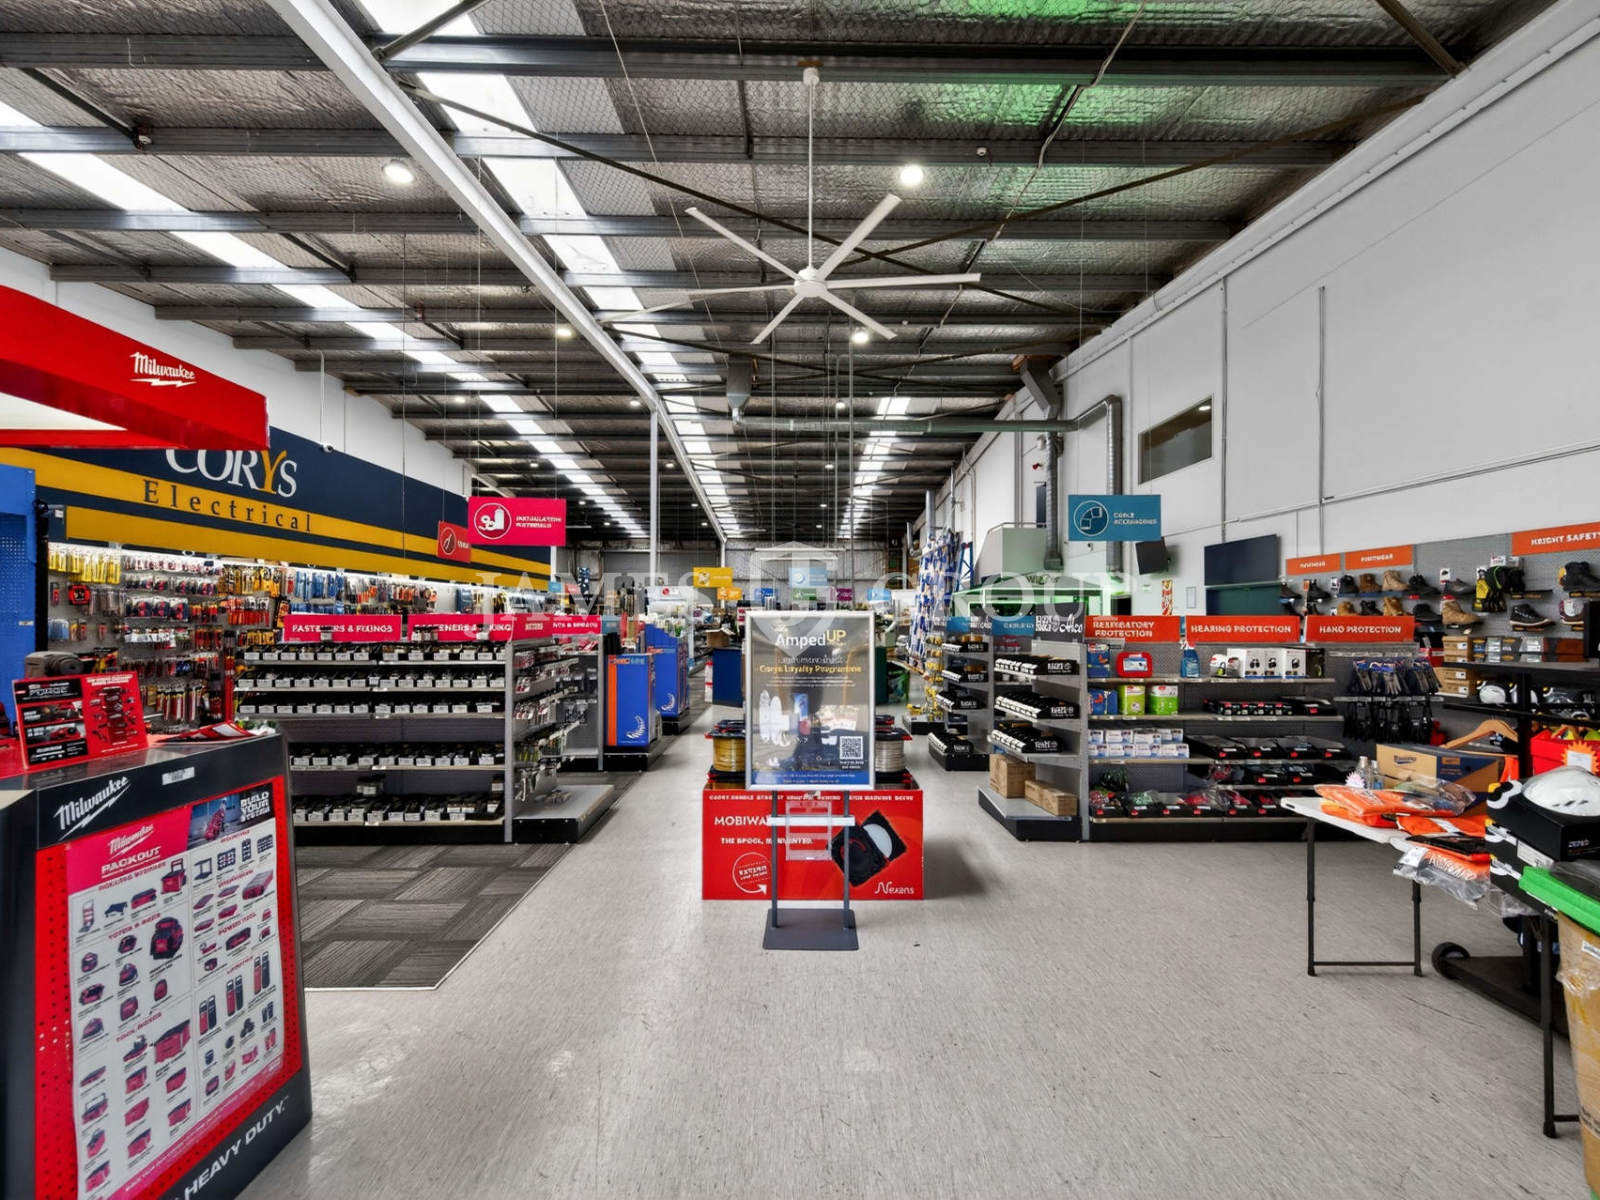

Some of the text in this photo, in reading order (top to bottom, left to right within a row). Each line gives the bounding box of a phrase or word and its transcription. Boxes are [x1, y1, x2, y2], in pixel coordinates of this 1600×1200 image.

[130, 352, 195, 379] Milwaukee
[165, 449, 298, 497] CORYS
[143, 480, 312, 533] Electrical
[292, 624, 346, 632] FASTERS
[1095, 629, 1153, 637] PROTECTION
[1191, 624, 1292, 633] HEARING PROTECTION
[1319, 624, 1402, 634] HAND PROTECTION
[54, 776, 129, 830] Milwaukee
[714, 815, 768, 827] MOBIWA
[101, 846, 162, 874] PACKOUT
[874, 881, 915, 895] Nexans
[184, 1138, 242, 1200] HEAVY
